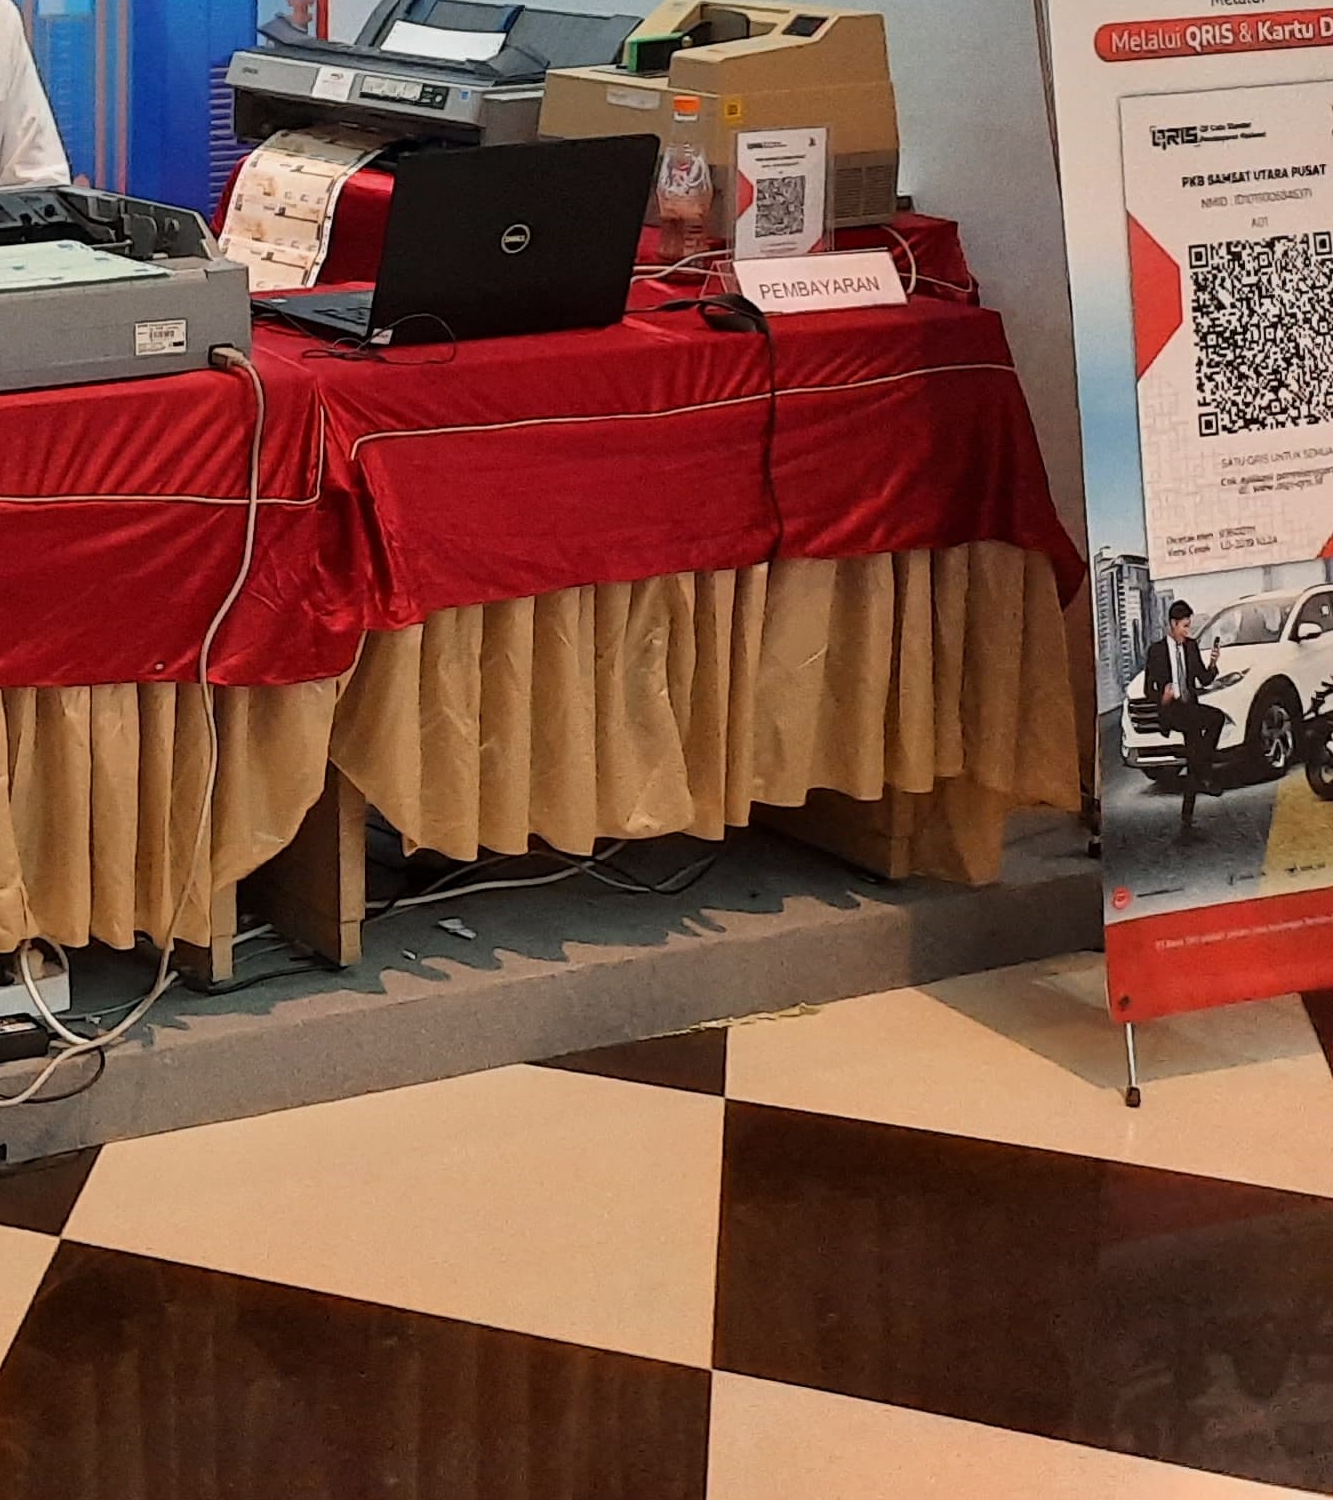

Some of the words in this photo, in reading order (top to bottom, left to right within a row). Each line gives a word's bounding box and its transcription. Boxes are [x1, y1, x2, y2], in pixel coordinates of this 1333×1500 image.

[1111, 27, 1181, 52] Melalui
[1185, 23, 1233, 52] QRIS
[1239, 23, 1252, 43] &
[1257, 19, 1313, 41] Kartu
[1181, 175, 1205, 188] PKB
[1207, 170, 1250, 186] SAMSAT
[1253, 167, 1288, 181] UTARA
[1291, 164, 1327, 178] PUSAT
[759, 276, 881, 299] PEMBAYARAN
